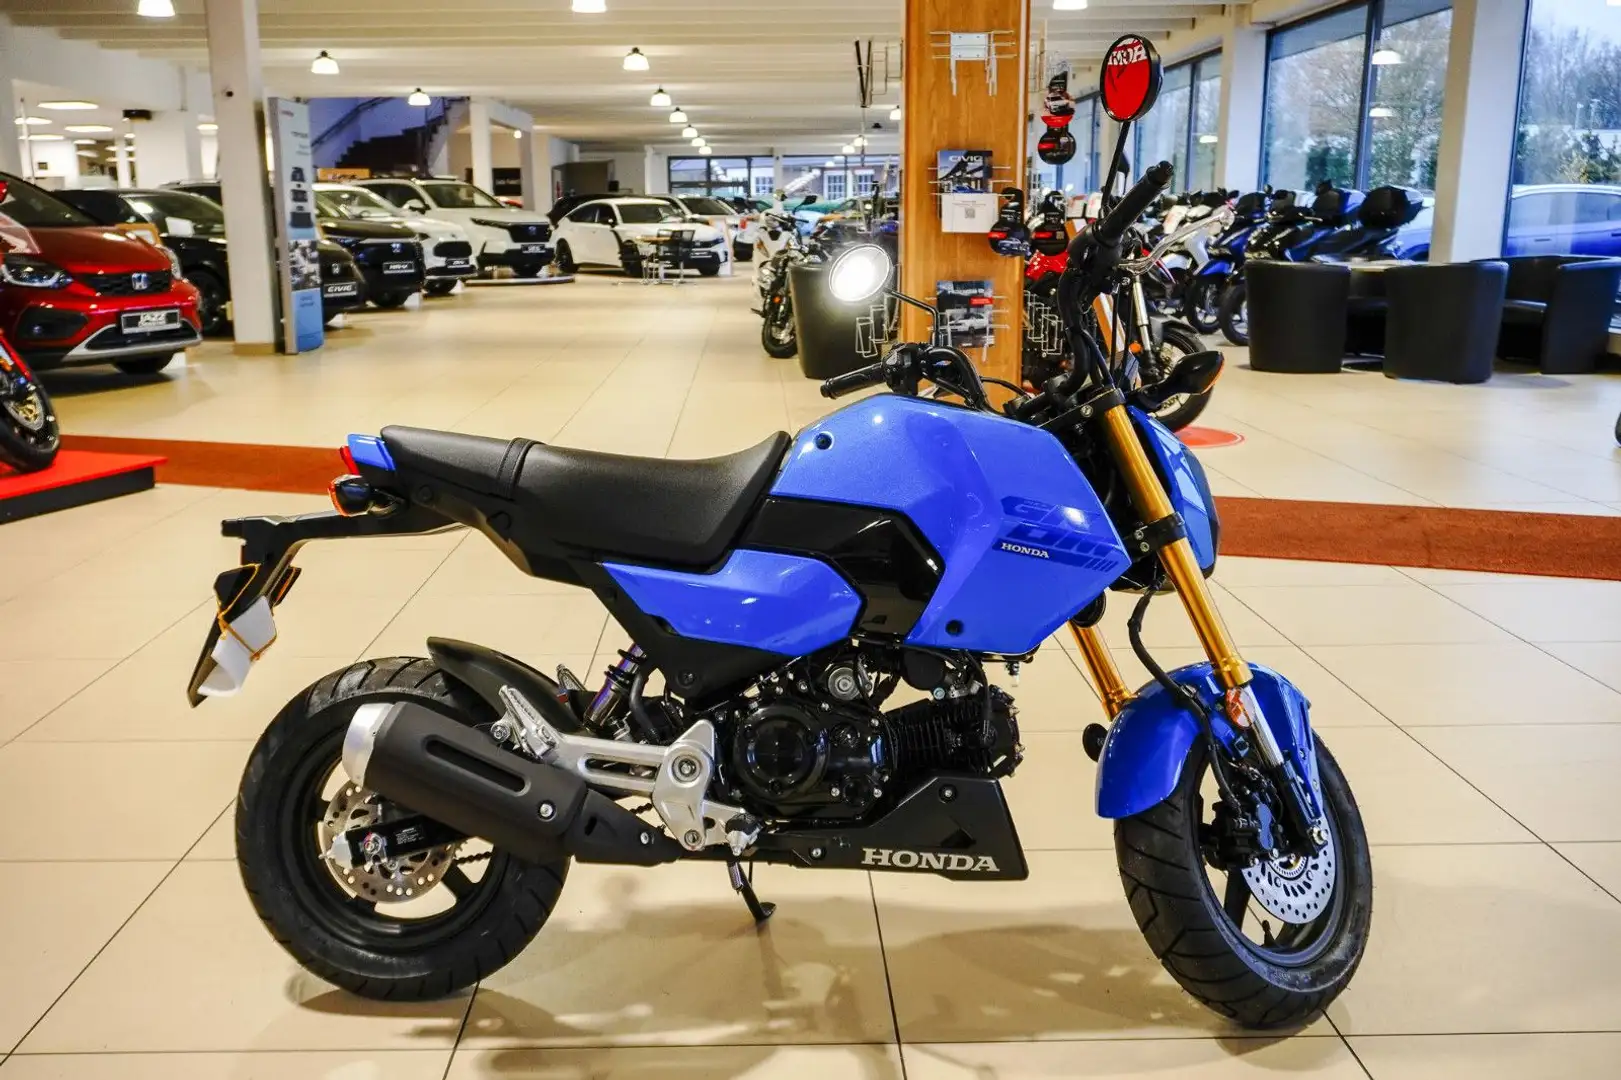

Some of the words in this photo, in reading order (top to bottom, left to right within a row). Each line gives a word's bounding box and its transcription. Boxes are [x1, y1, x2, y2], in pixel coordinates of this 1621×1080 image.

[327, 284, 352, 293] CIVIC
[1001, 542, 1050, 559] HONDA
[861, 847, 1000, 872] HONDA
